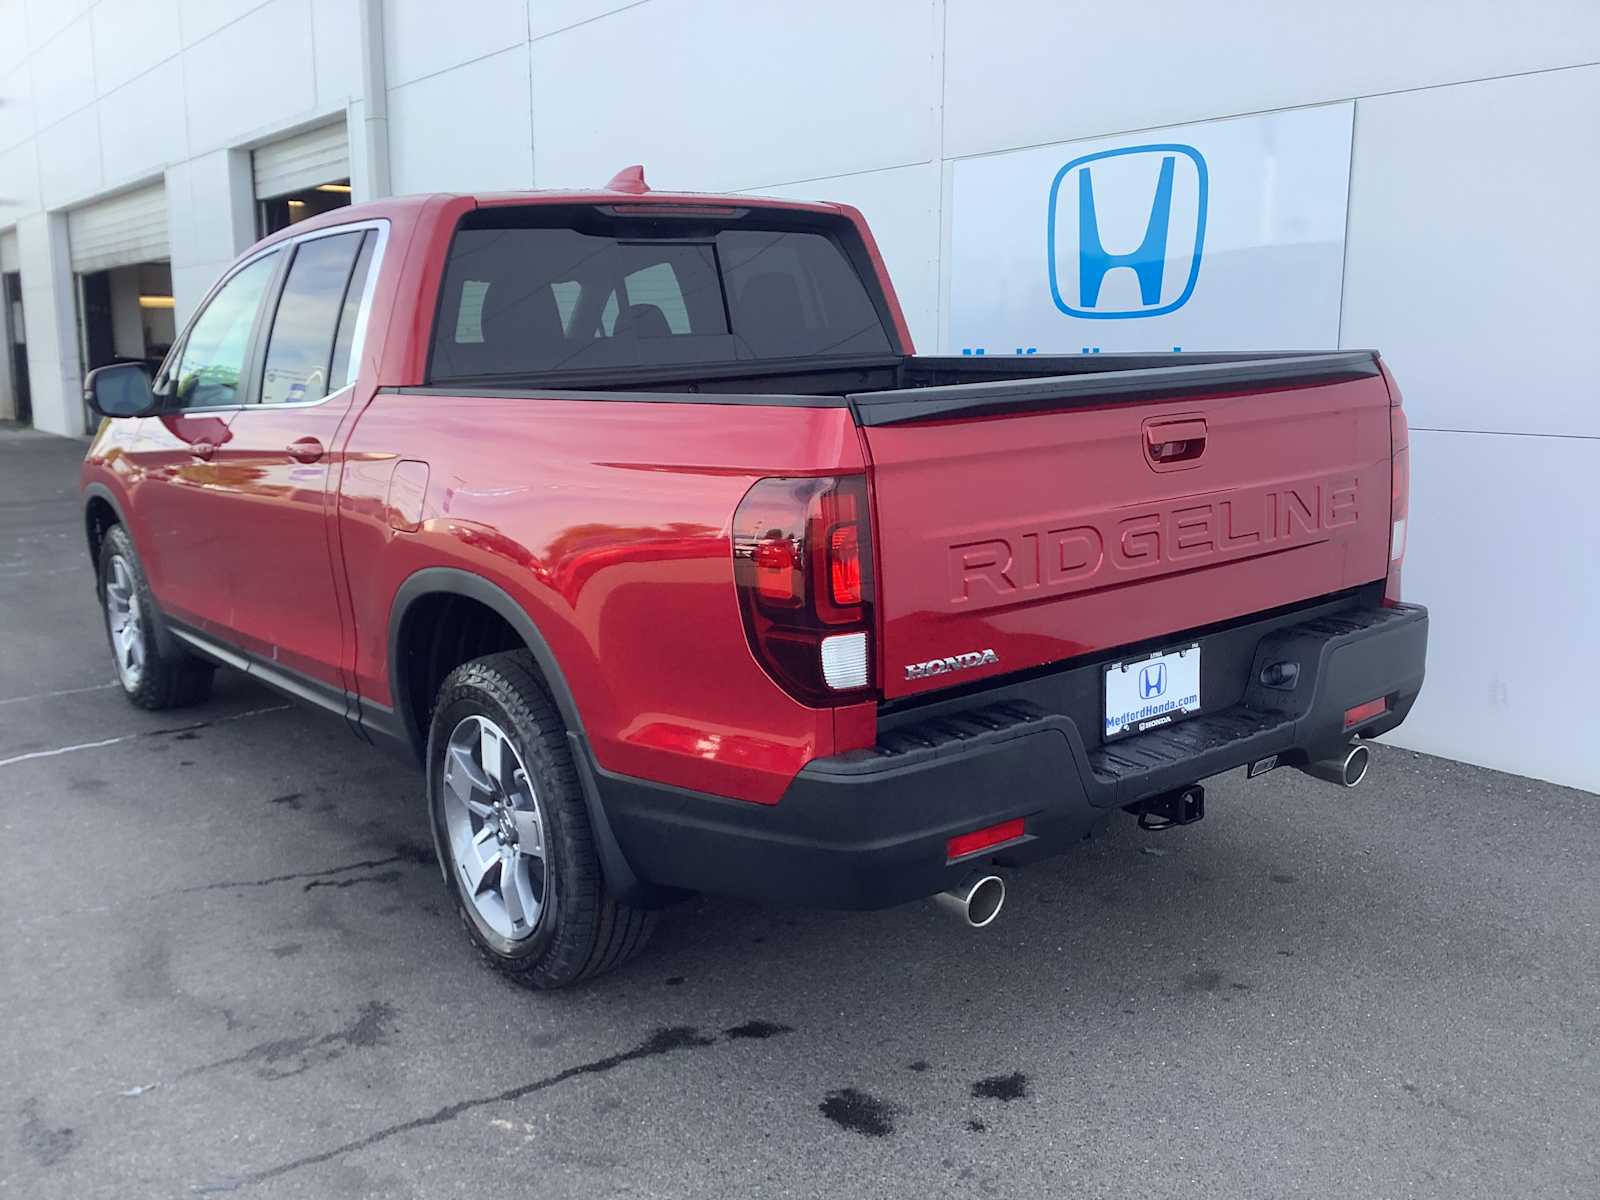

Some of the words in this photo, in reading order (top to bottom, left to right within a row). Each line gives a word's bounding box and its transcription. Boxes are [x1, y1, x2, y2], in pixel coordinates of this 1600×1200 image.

[948, 478, 1360, 604] RIDGELINE
[904, 648, 999, 680] HONDA
[1106, 693, 1198, 728] MedfordHonda.com
